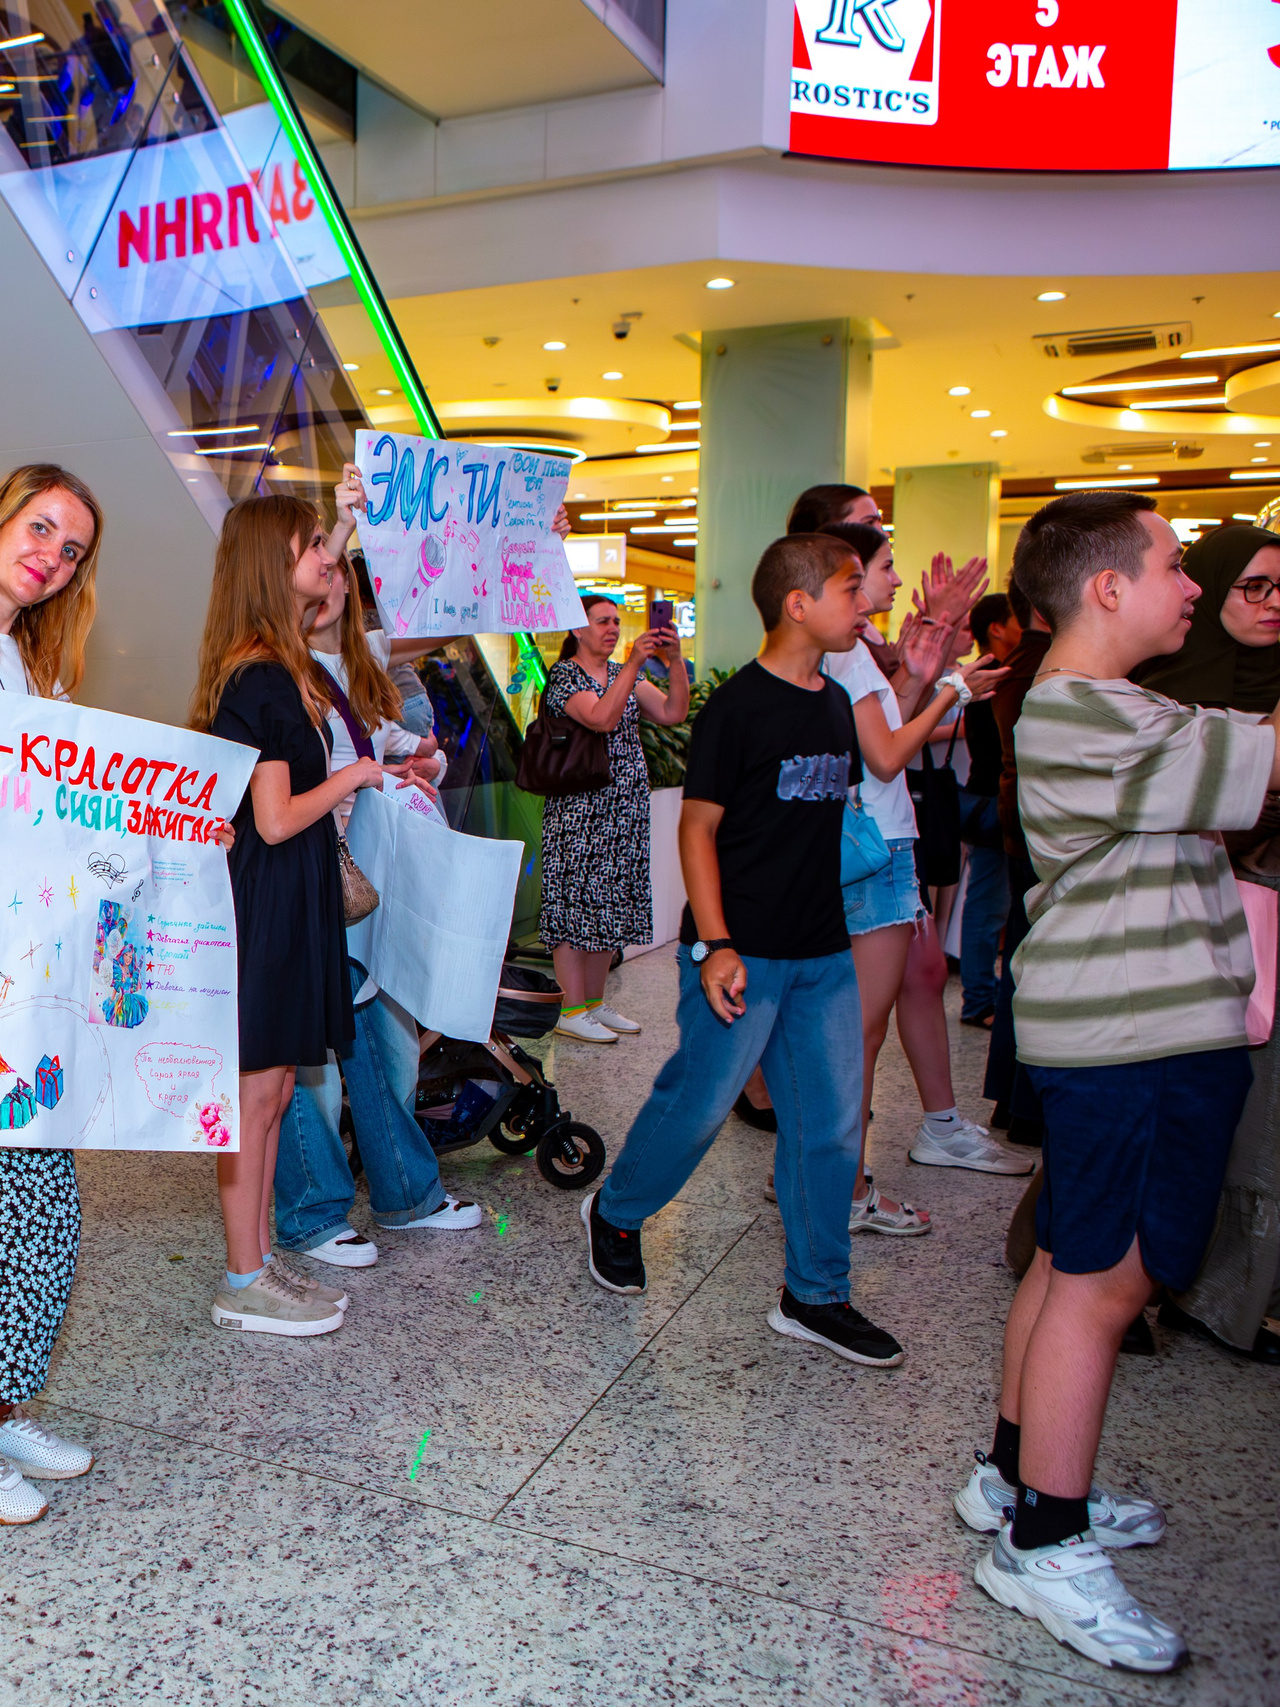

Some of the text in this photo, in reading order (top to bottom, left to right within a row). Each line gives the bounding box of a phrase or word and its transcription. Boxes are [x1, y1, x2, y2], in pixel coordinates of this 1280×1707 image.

[985, 43, 1107, 88] ЭТАЖ
[792, 80, 931, 114] ROSTIC'S
[463, 460, 506, 528] ТИ
[501, 576, 529, 603] ТЮ
[500, 600, 558, 629] ШАЙНИ
[156, 963, 175, 976] ТЮ
